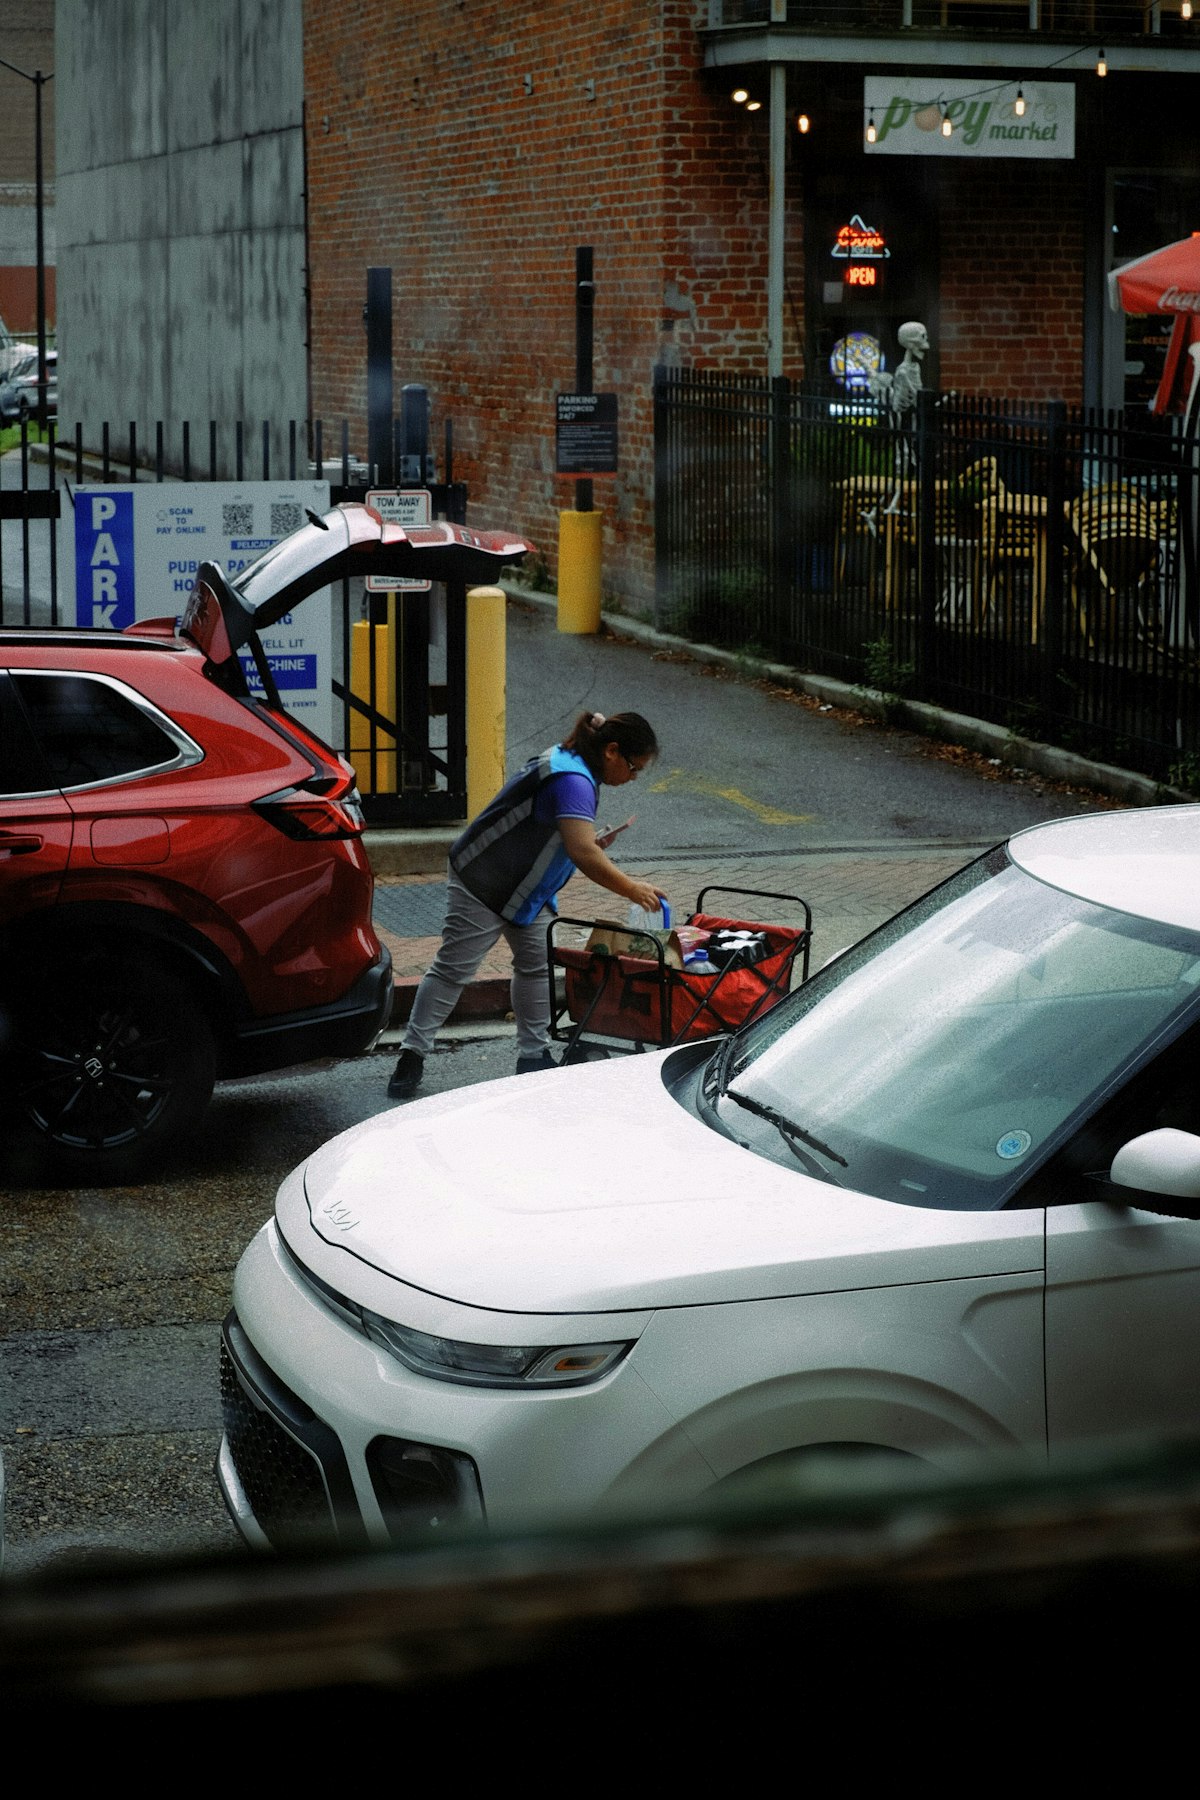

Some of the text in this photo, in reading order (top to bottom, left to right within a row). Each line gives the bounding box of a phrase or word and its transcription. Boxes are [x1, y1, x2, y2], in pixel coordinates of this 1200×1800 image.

[989, 122, 1058, 141] market
[558, 395, 598, 404] PARKING
[377, 497, 420, 507] TOW AWAY
[169, 508, 193, 516] SCAN
[175, 526, 206, 534] ONLINE
[237, 541, 270, 550] PELICAN
[289, 639, 305, 648] LIT
[246, 659, 306, 672] MCHINE
